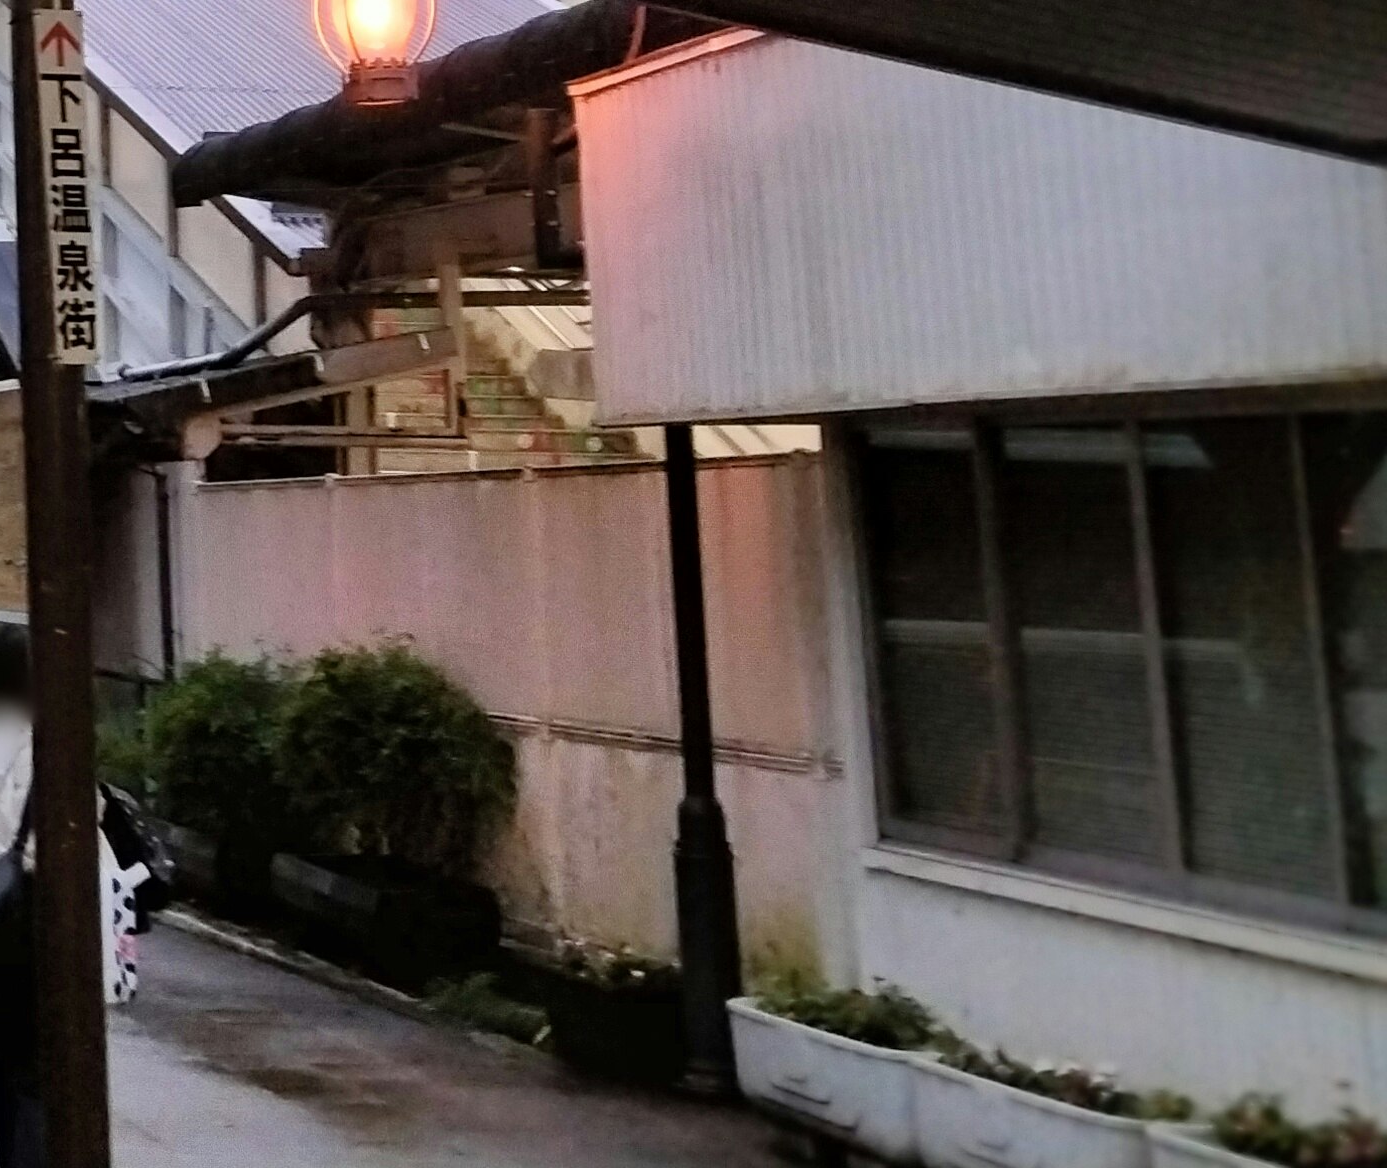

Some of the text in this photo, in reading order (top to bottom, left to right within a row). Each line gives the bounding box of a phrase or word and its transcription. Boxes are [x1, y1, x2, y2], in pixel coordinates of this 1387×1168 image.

[40, 72, 96, 351] 下呂温泉街
